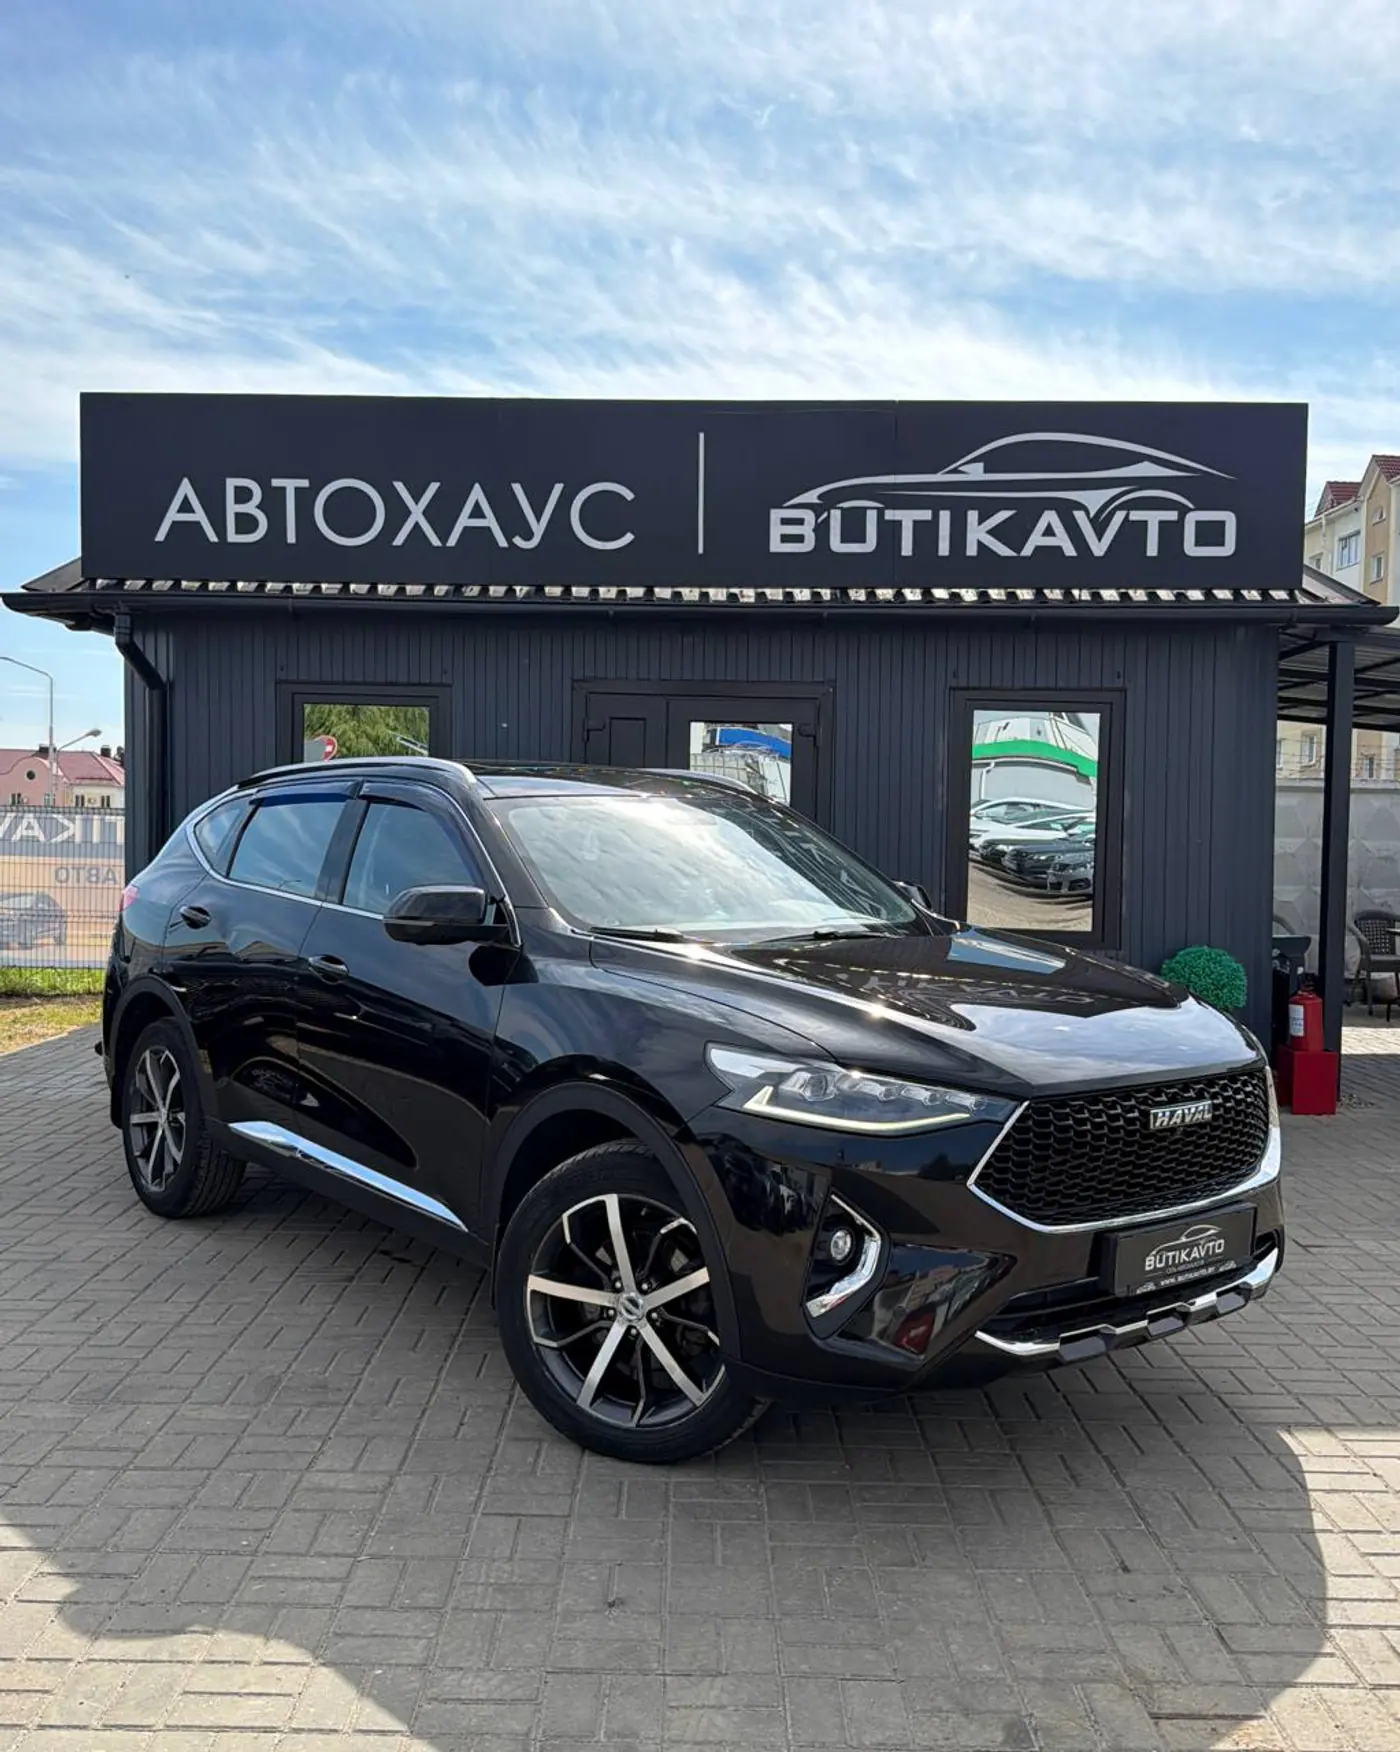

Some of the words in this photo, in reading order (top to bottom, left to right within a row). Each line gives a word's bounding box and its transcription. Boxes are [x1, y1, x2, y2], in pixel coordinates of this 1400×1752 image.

[154, 477, 635, 550] АВТОХАУС
[769, 508, 1237, 557] BUTIKAVTO
[1154, 1104, 1213, 1127] HAVAL
[1144, 1239, 1225, 1272] BUTIKAVTO
